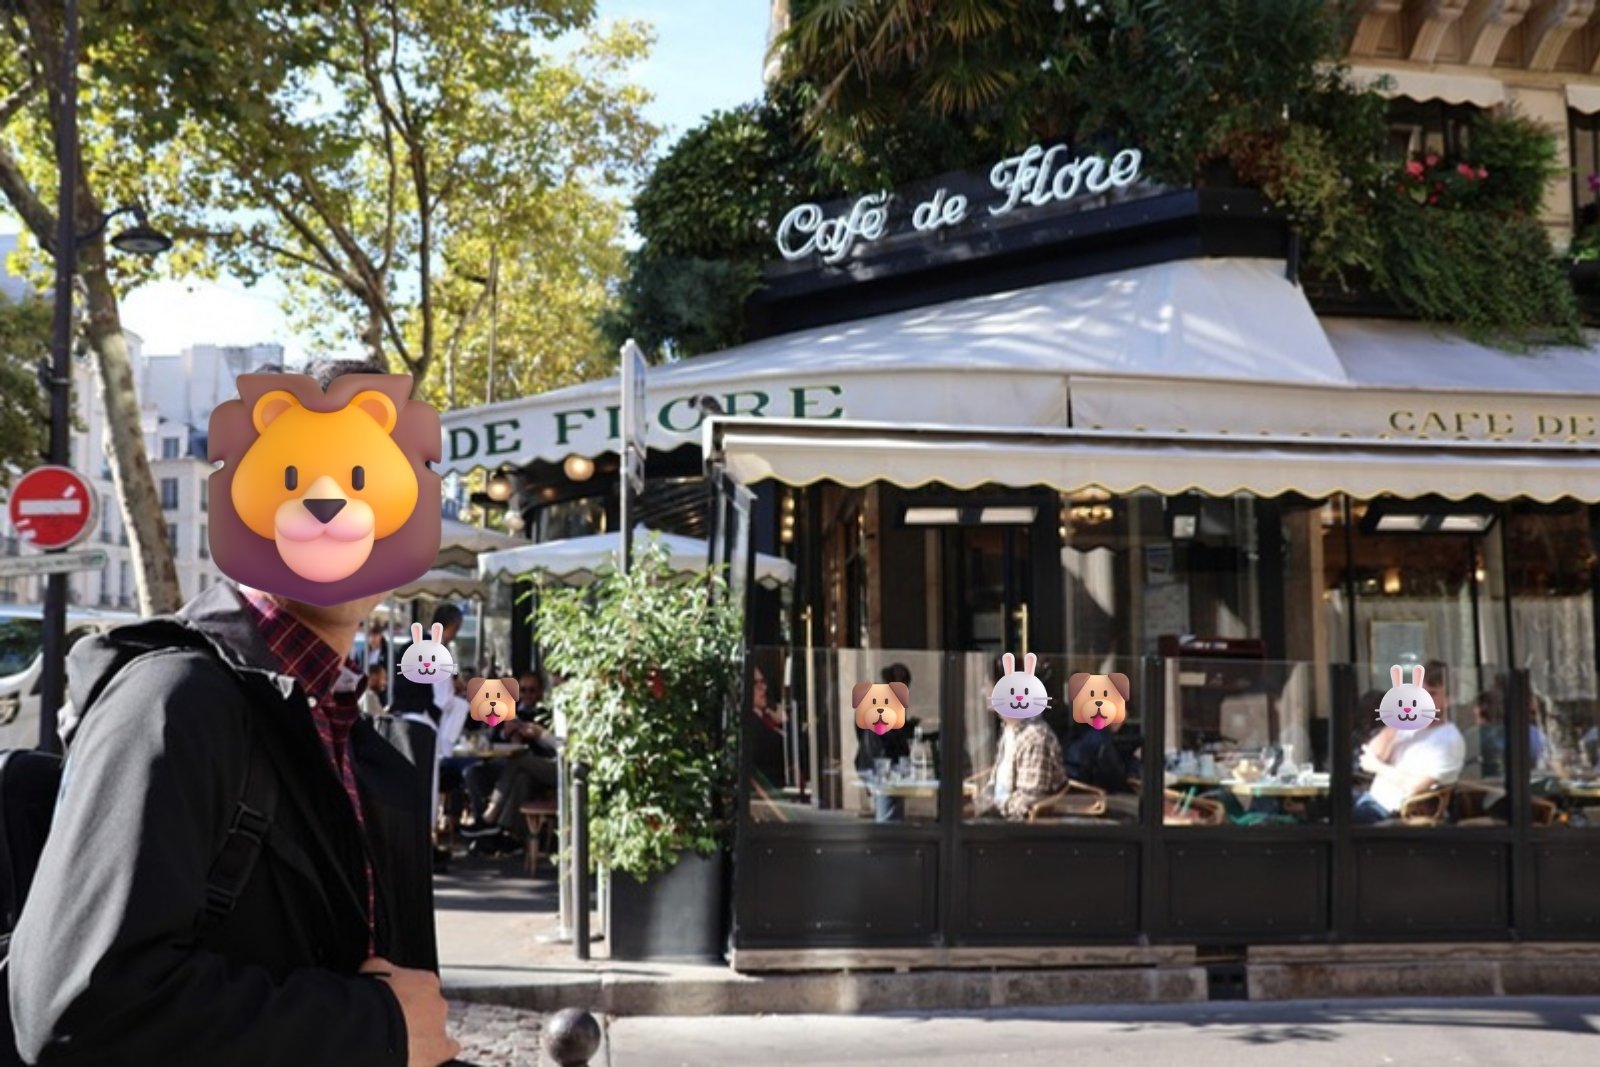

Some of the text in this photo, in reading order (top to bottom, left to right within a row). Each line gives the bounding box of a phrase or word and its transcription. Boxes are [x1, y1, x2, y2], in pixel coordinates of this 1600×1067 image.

[777, 143, 1142, 263] Café de Flore
[448, 419, 522, 461] DE
[1537, 415, 1595, 437] DE
